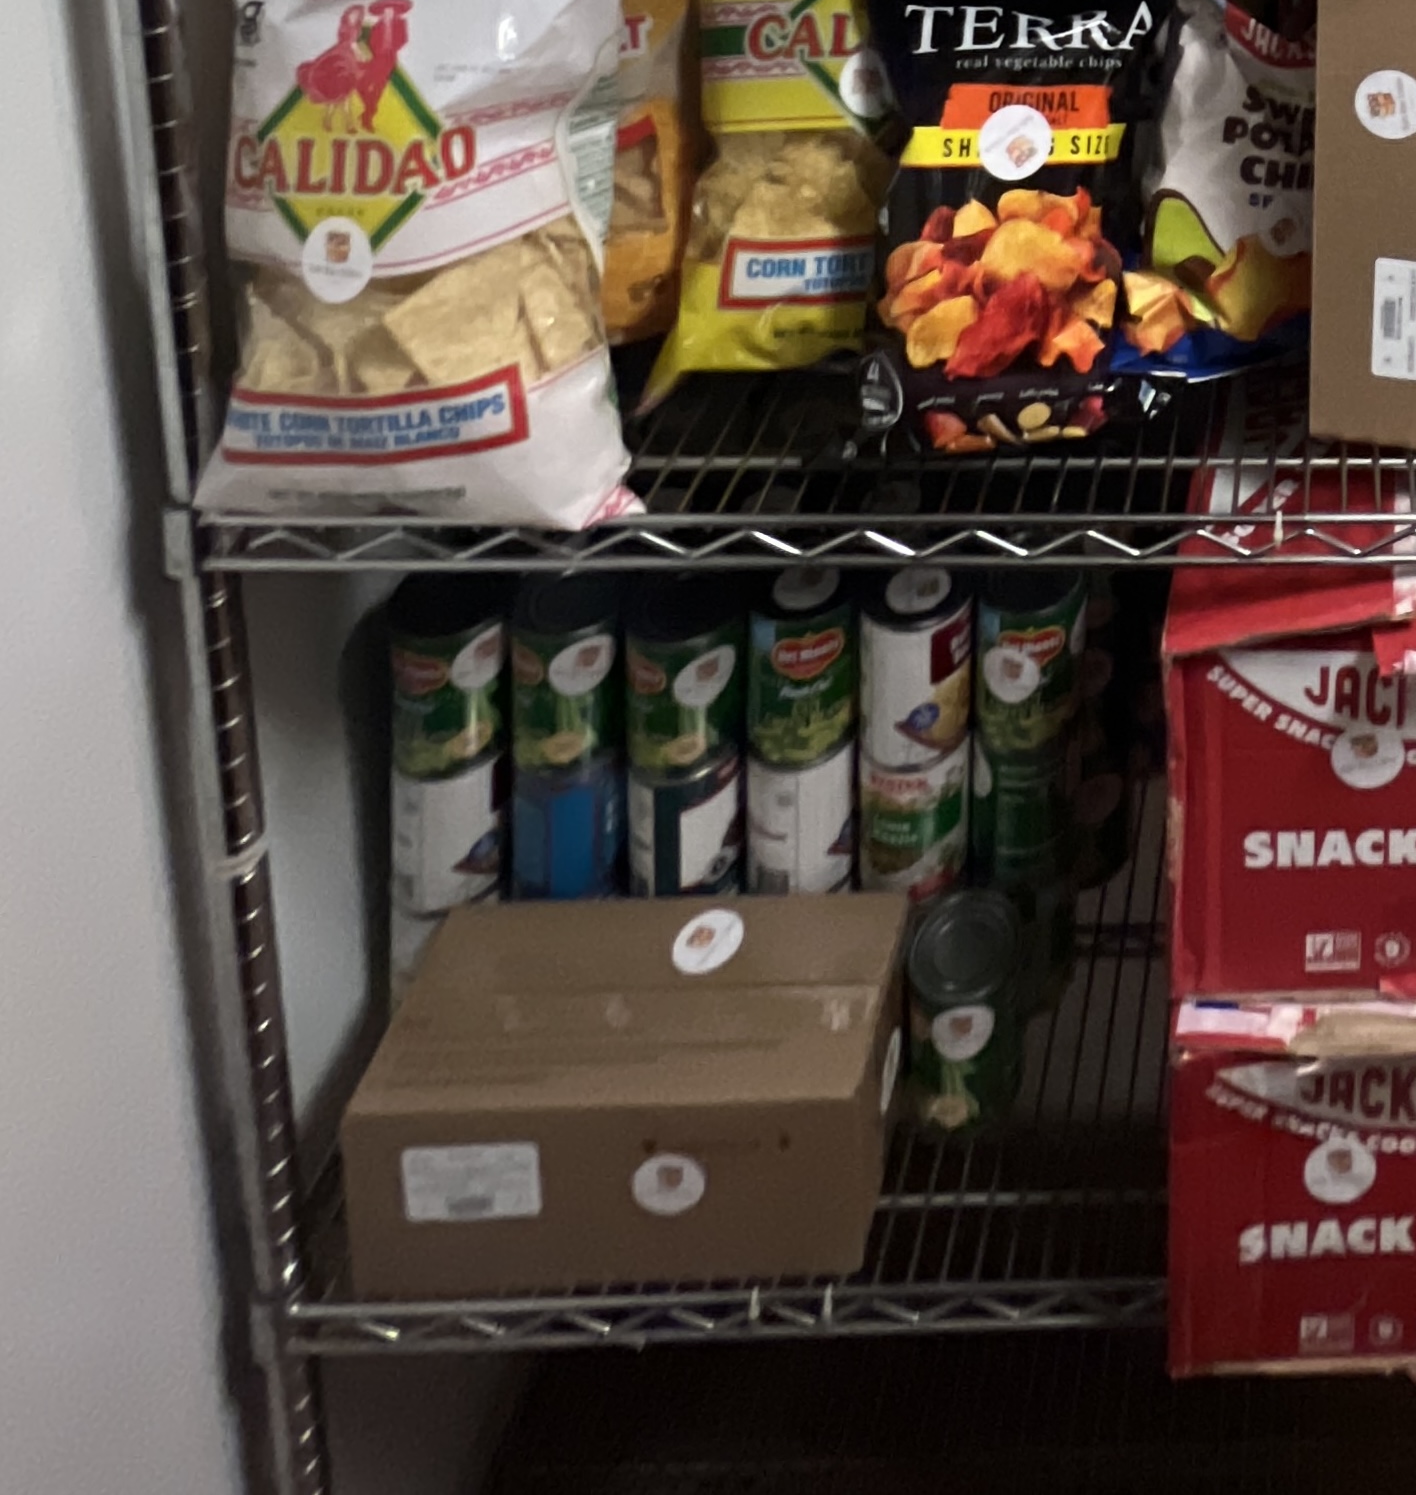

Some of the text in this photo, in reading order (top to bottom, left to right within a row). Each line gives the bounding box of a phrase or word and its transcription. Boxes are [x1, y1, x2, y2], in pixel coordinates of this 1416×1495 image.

[904, 0, 1153, 55] TERRA
[955, 55, 1123, 71] real vegetable chips
[987, 90, 1080, 113] ORIGINAL
[746, 257, 806, 279] CORN
[337, 408, 433, 434] TORTILLA
[438, 393, 506, 425] CHIPS
[1207, 665, 1274, 720] SUPER
[1273, 712, 1336, 750] SNAC
[1238, 1215, 1416, 1266] SNACK
